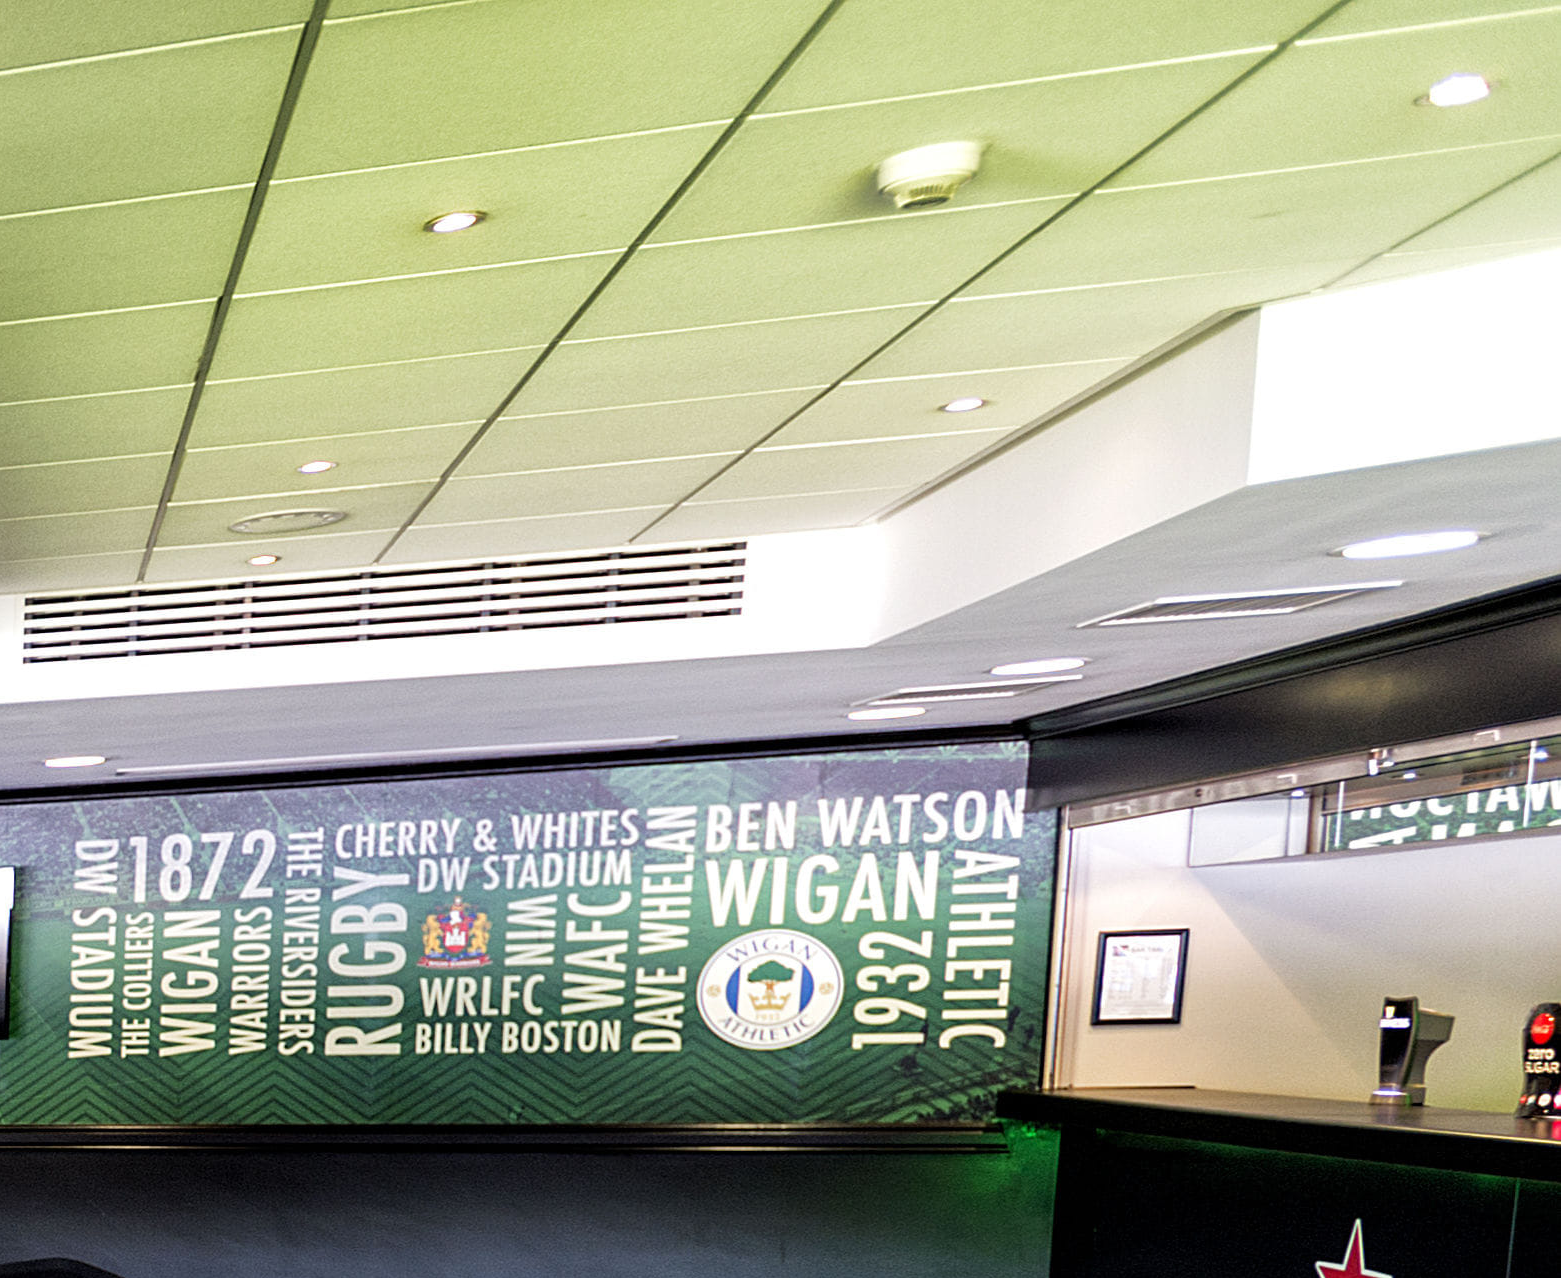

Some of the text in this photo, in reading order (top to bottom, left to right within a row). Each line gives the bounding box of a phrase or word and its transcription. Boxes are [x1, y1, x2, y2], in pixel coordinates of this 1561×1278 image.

[129, 828, 276, 904] 1872
[335, 807, 637, 859] CHERRY & WHITES
[417, 846, 633, 893] DW STADIUM
[705, 788, 1026, 853] BEN WATSON
[504, 893, 558, 966] NIM
[631, 804, 699, 1052] DAVE WHELAN
[704, 848, 941, 927] WIGAN
[66, 838, 120, 1059] DW STADIUM
[120, 911, 156, 1059] THE COLLIERS
[158, 909, 222, 1057] WIGAN
[228, 905, 274, 1055] WARRIORS
[278, 826, 325, 1056] THE RIVERSIDERS
[324, 865, 411, 1056] RUGBY
[561, 891, 633, 1015] WAFC
[727, 937, 819, 961] WIGAN
[852, 930, 934, 1050] 1932
[937, 848, 1022, 1048] ATHLETIC
[415, 1019, 622, 1055] BILLY BOSTON
[419, 973, 546, 1017] WRLFC
[718, 1014, 815, 1041] ATHLETIC
